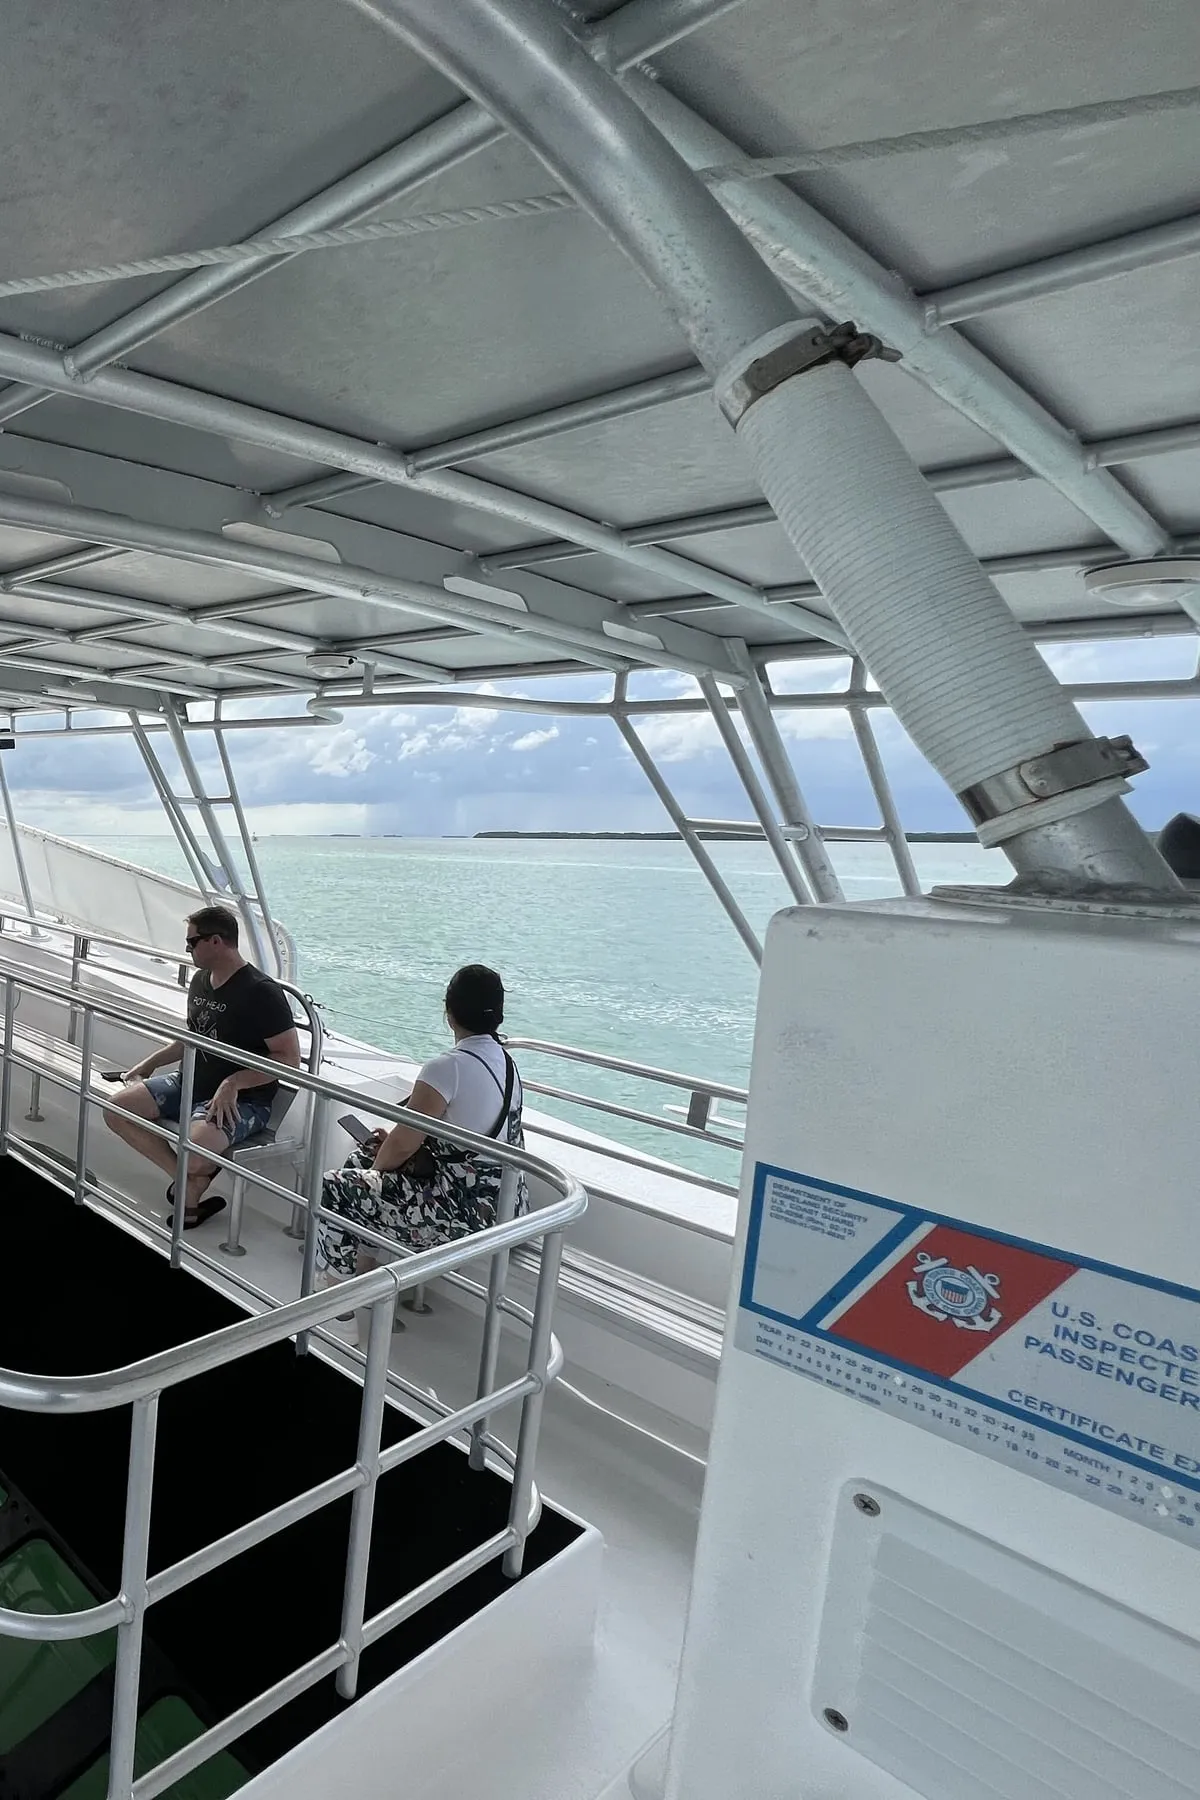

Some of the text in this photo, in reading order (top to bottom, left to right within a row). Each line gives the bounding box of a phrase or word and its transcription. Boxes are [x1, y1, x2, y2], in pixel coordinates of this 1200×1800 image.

[206, 1000, 227, 1012] HEAD
[772, 1182, 831, 1204] DEPARTMENT
[789, 1203, 819, 1217] COAST
[822, 1205, 868, 1223] SECURITY
[1051, 1301, 1198, 1362] U.S. COAS
[1054, 1324, 1199, 1386] INSPECTE
[758, 1321, 782, 1337] YEAR
[800, 1339, 811, 1350] 22
[815, 1345, 826, 1355] 23
[830, 1351, 842, 1361] 24
[845, 1358, 857, 1368] 25
[861, 1364, 873, 1374] 26
[878, 1370, 891, 1380] 27
[911, 1384, 924, 1396] 29
[945, 1399, 958, 1410] 31
[964, 1407, 978, 1418] 32
[982, 1414, 996, 1426] 33
[1002, 1422, 1016, 1433] 34
[1021, 1430, 1036, 1441] 35
[1024, 1335, 1200, 1411] PASSENGER
[756, 1335, 774, 1348] DAY
[787, 1348, 793, 1356] 2
[796, 1352, 803, 1360] 3
[806, 1356, 812, 1364] 4
[816, 1360, 822, 1368] 5
[825, 1364, 832, 1372] 6
[836, 1368, 842, 1376] 7
[845, 1372, 852, 1380] 8
[856, 1377, 862, 1385] 9
[866, 1381, 877, 1392] 10
[882, 1388, 892, 1397] 11
[896, 1394, 908, 1404] 12
[914, 1401, 926, 1412] 13
[931, 1408, 943, 1420] 14
[949, 1416, 961, 1428] 15
[968, 1424, 980, 1436] 16
[986, 1432, 1000, 1442] 17
[1005, 1440, 1018, 1452] 18
[1025, 1449, 1038, 1460] 19
[1064, 1466, 1079, 1477] 21
[1085, 1474, 1100, 1486] 22
[1128, 1492, 1145, 1505] 24
[1008, 1389, 1166, 1461] CERTIFICATE
[1063, 1447, 1110, 1473] MONTH
[1117, 1470, 1124, 1479] 1
[1130, 1475, 1138, 1485] 2
